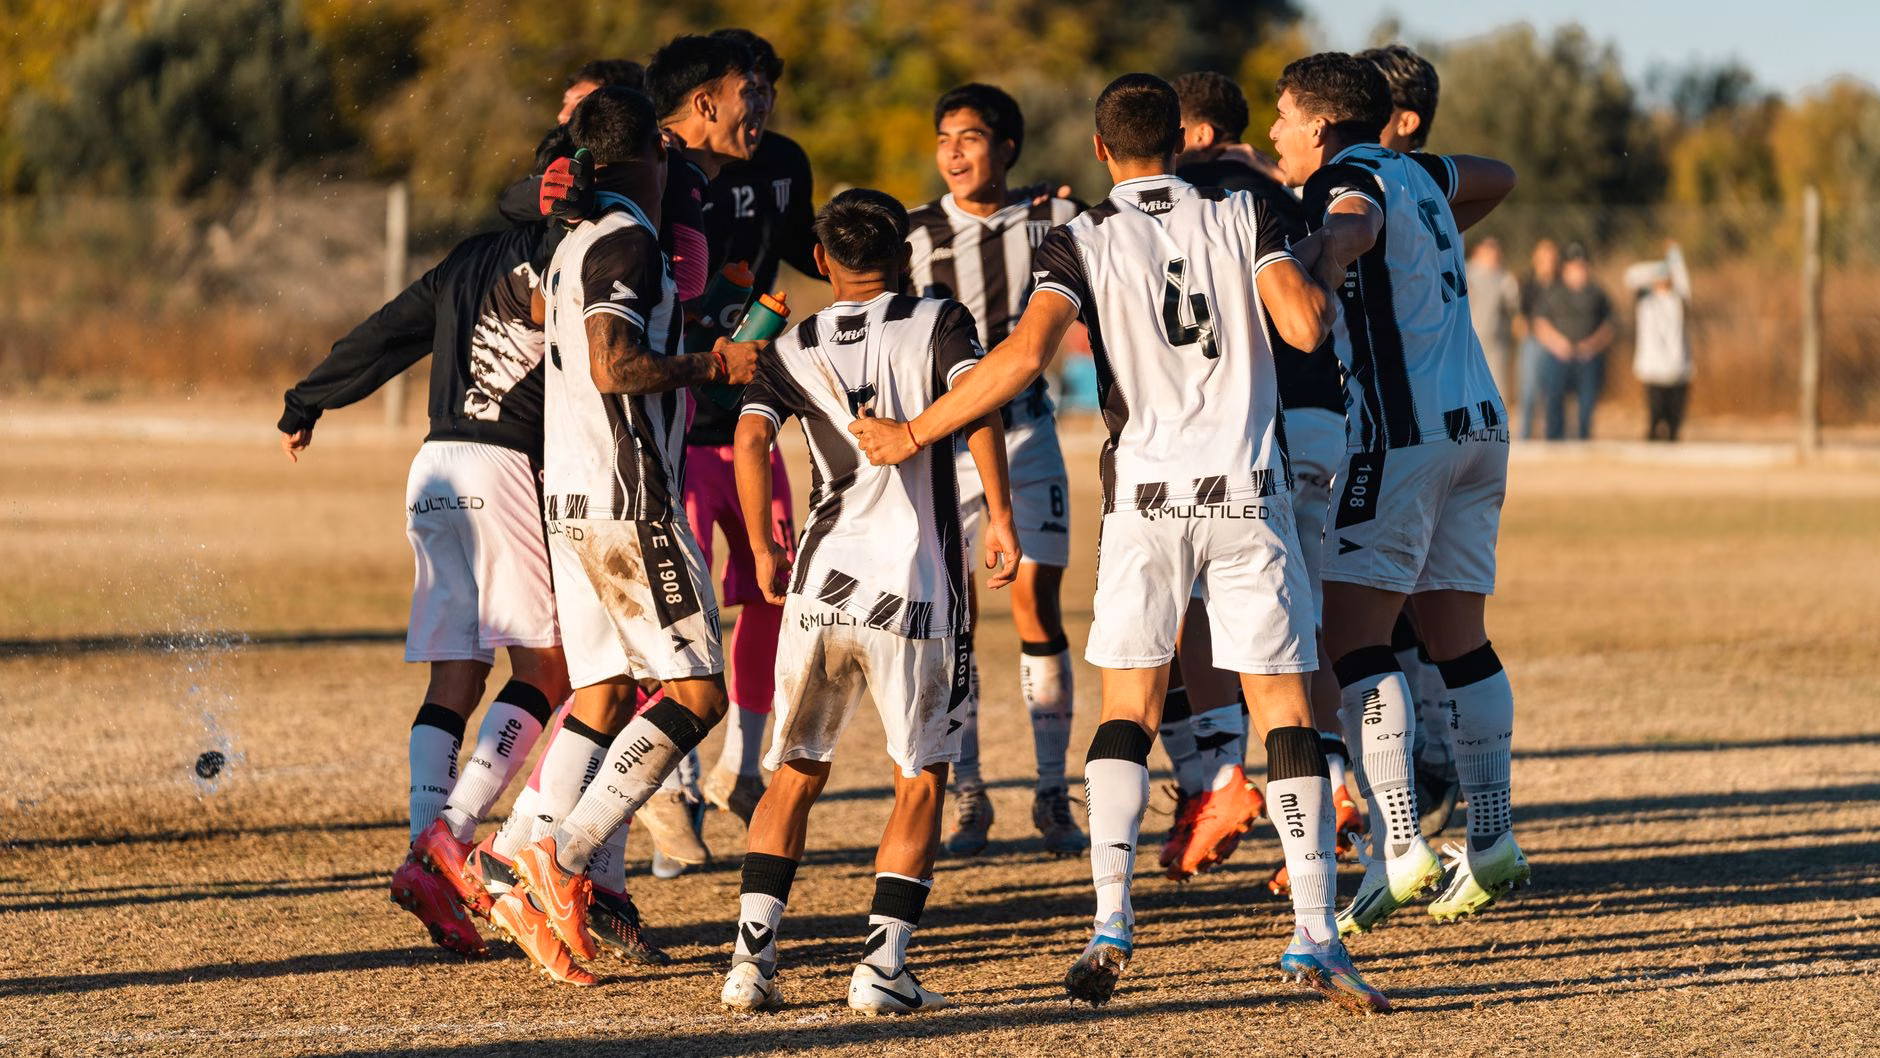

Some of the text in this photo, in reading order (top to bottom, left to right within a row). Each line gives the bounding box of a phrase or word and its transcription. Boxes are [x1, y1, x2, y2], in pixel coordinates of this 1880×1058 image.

[731, 185, 755, 218] 12
[1163, 257, 1220, 359] 4
[1350, 464, 1372, 508] 1908
[1159, 505, 1270, 520] MULTILED
[658, 559, 682, 604] 1908
[1362, 687, 1387, 726] mitre
[496, 718, 522, 758] mitre
[1377, 730, 1412, 741] GYE
[614, 736, 655, 775] mitre
[423, 785, 448, 796] 1908
[607, 785, 637, 806] GYE
[1280, 793, 1307, 839] mitre
[1305, 851, 1332, 861] GYE
